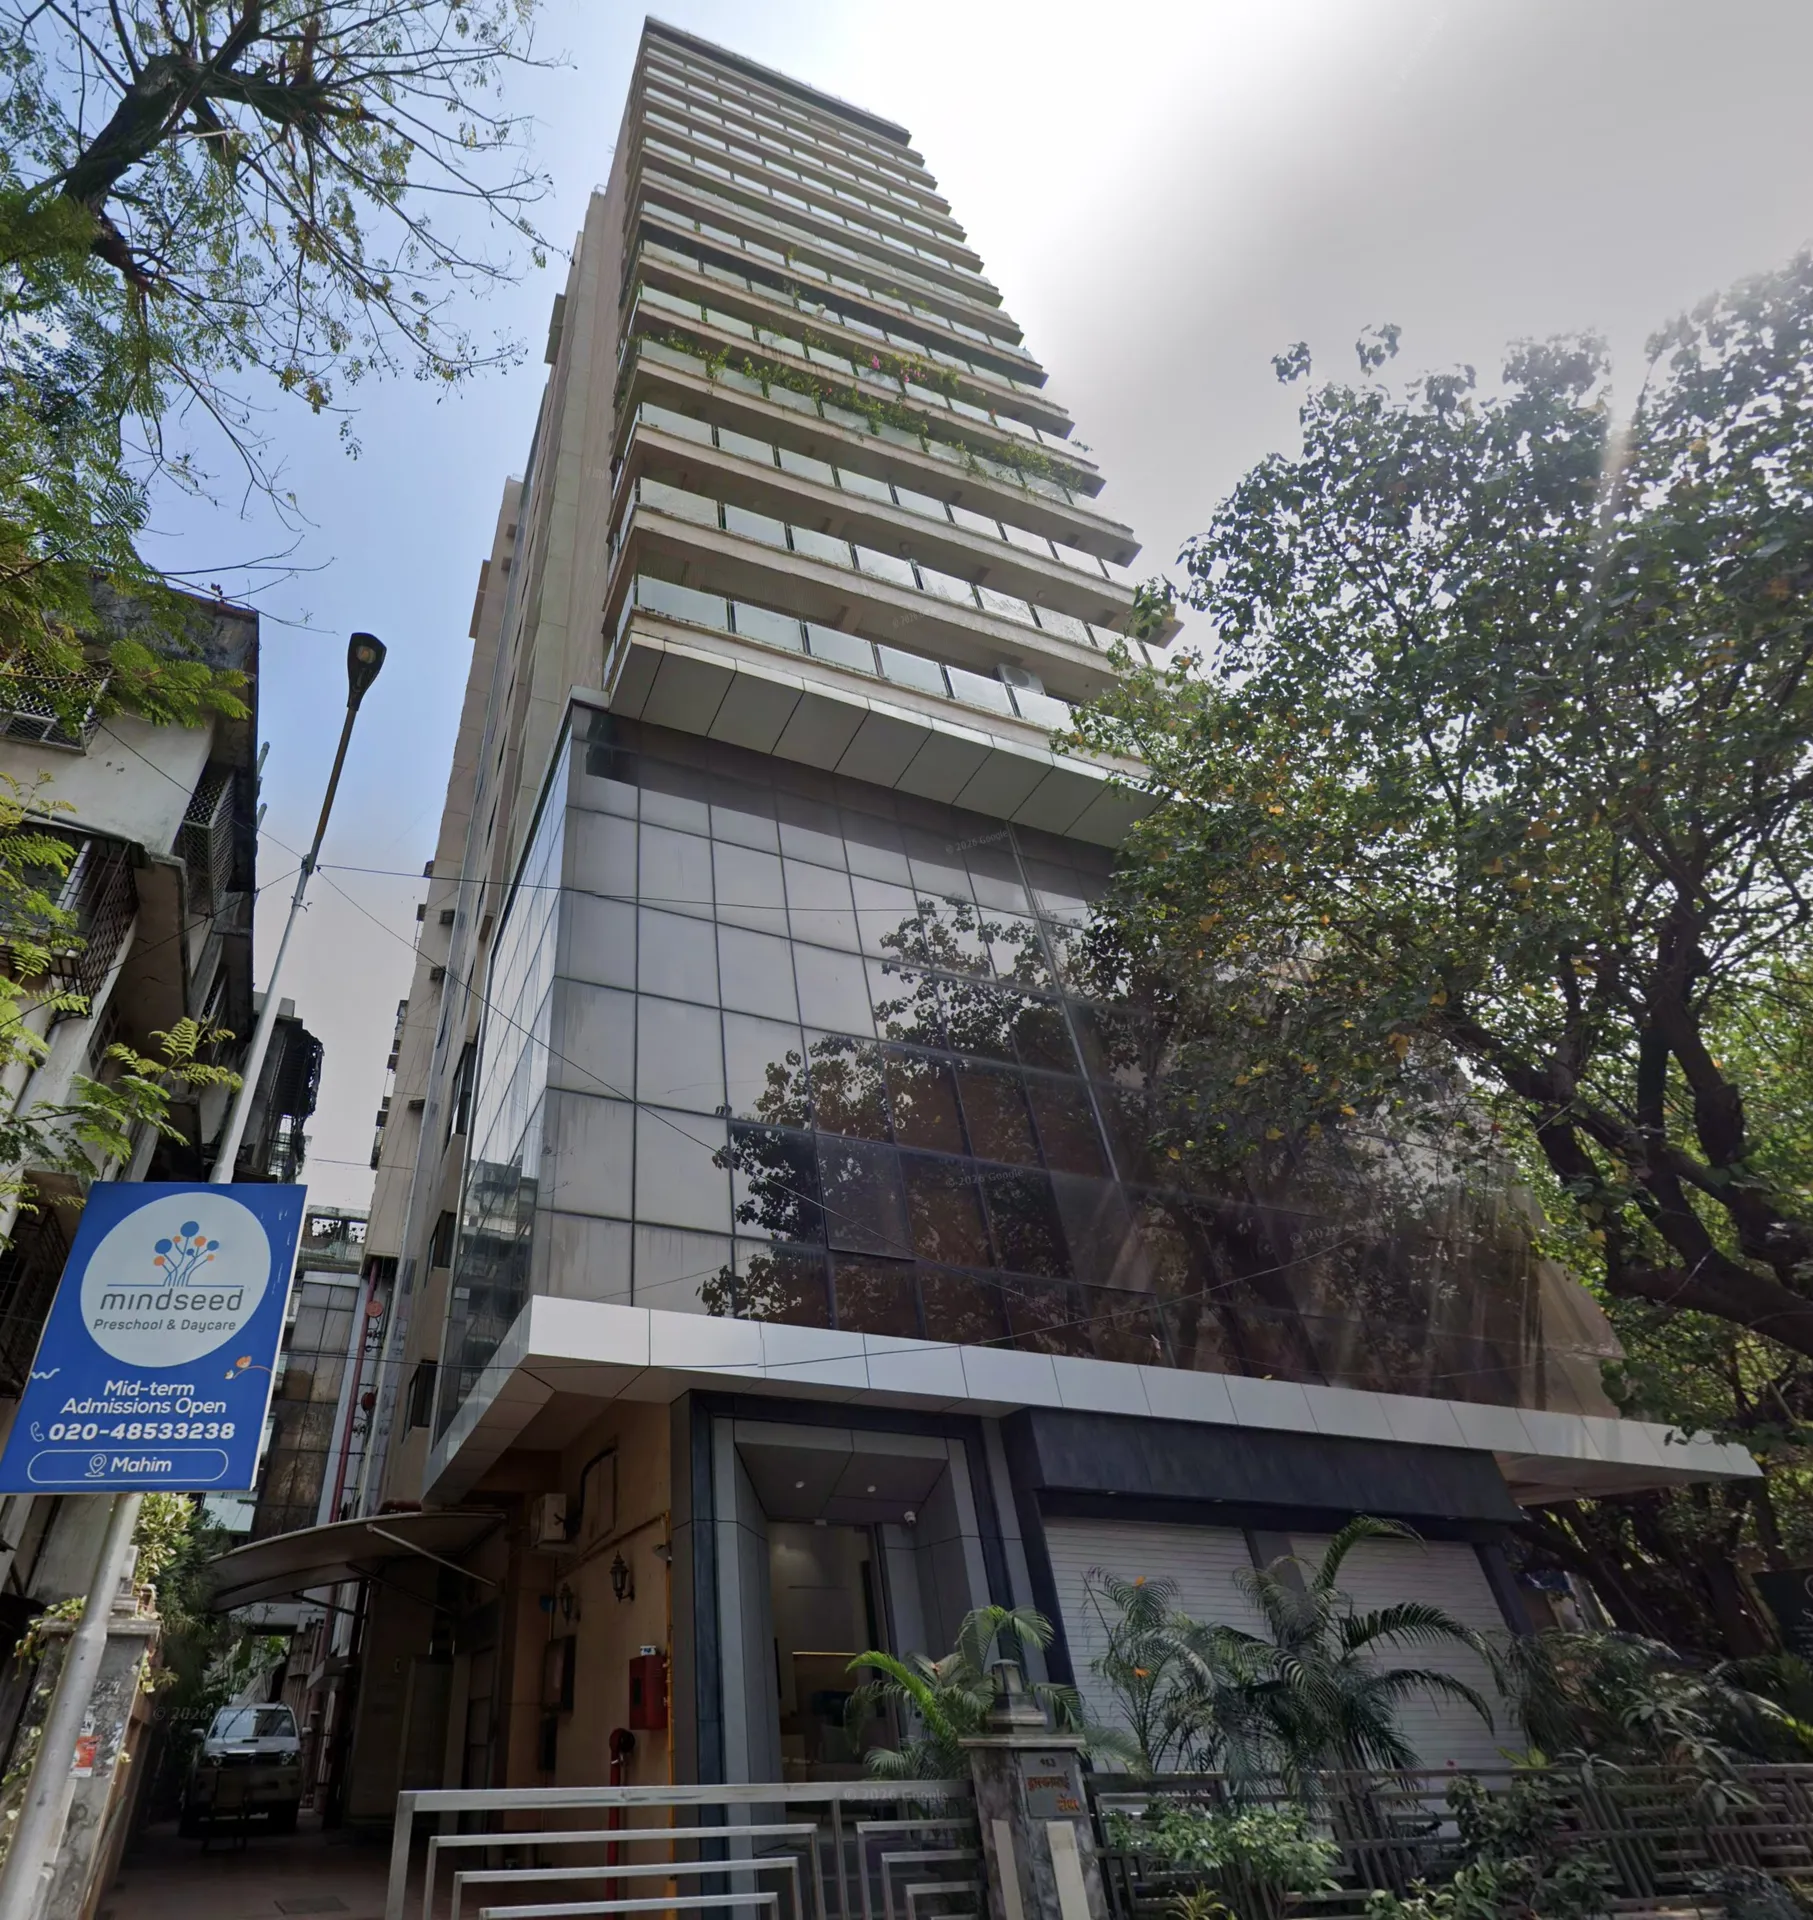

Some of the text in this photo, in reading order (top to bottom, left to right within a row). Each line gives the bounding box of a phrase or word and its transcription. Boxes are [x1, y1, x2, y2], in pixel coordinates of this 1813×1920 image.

[100, 1288, 244, 1311] mindseed
[93, 1319, 236, 1333] Preschool & Daycare
[103, 1380, 195, 1397] Mid-term
[60, 1398, 227, 1418] Admissions Open
[49, 1423, 235, 1441] 020-48533238
[110, 1457, 172, 1473] Mahim
